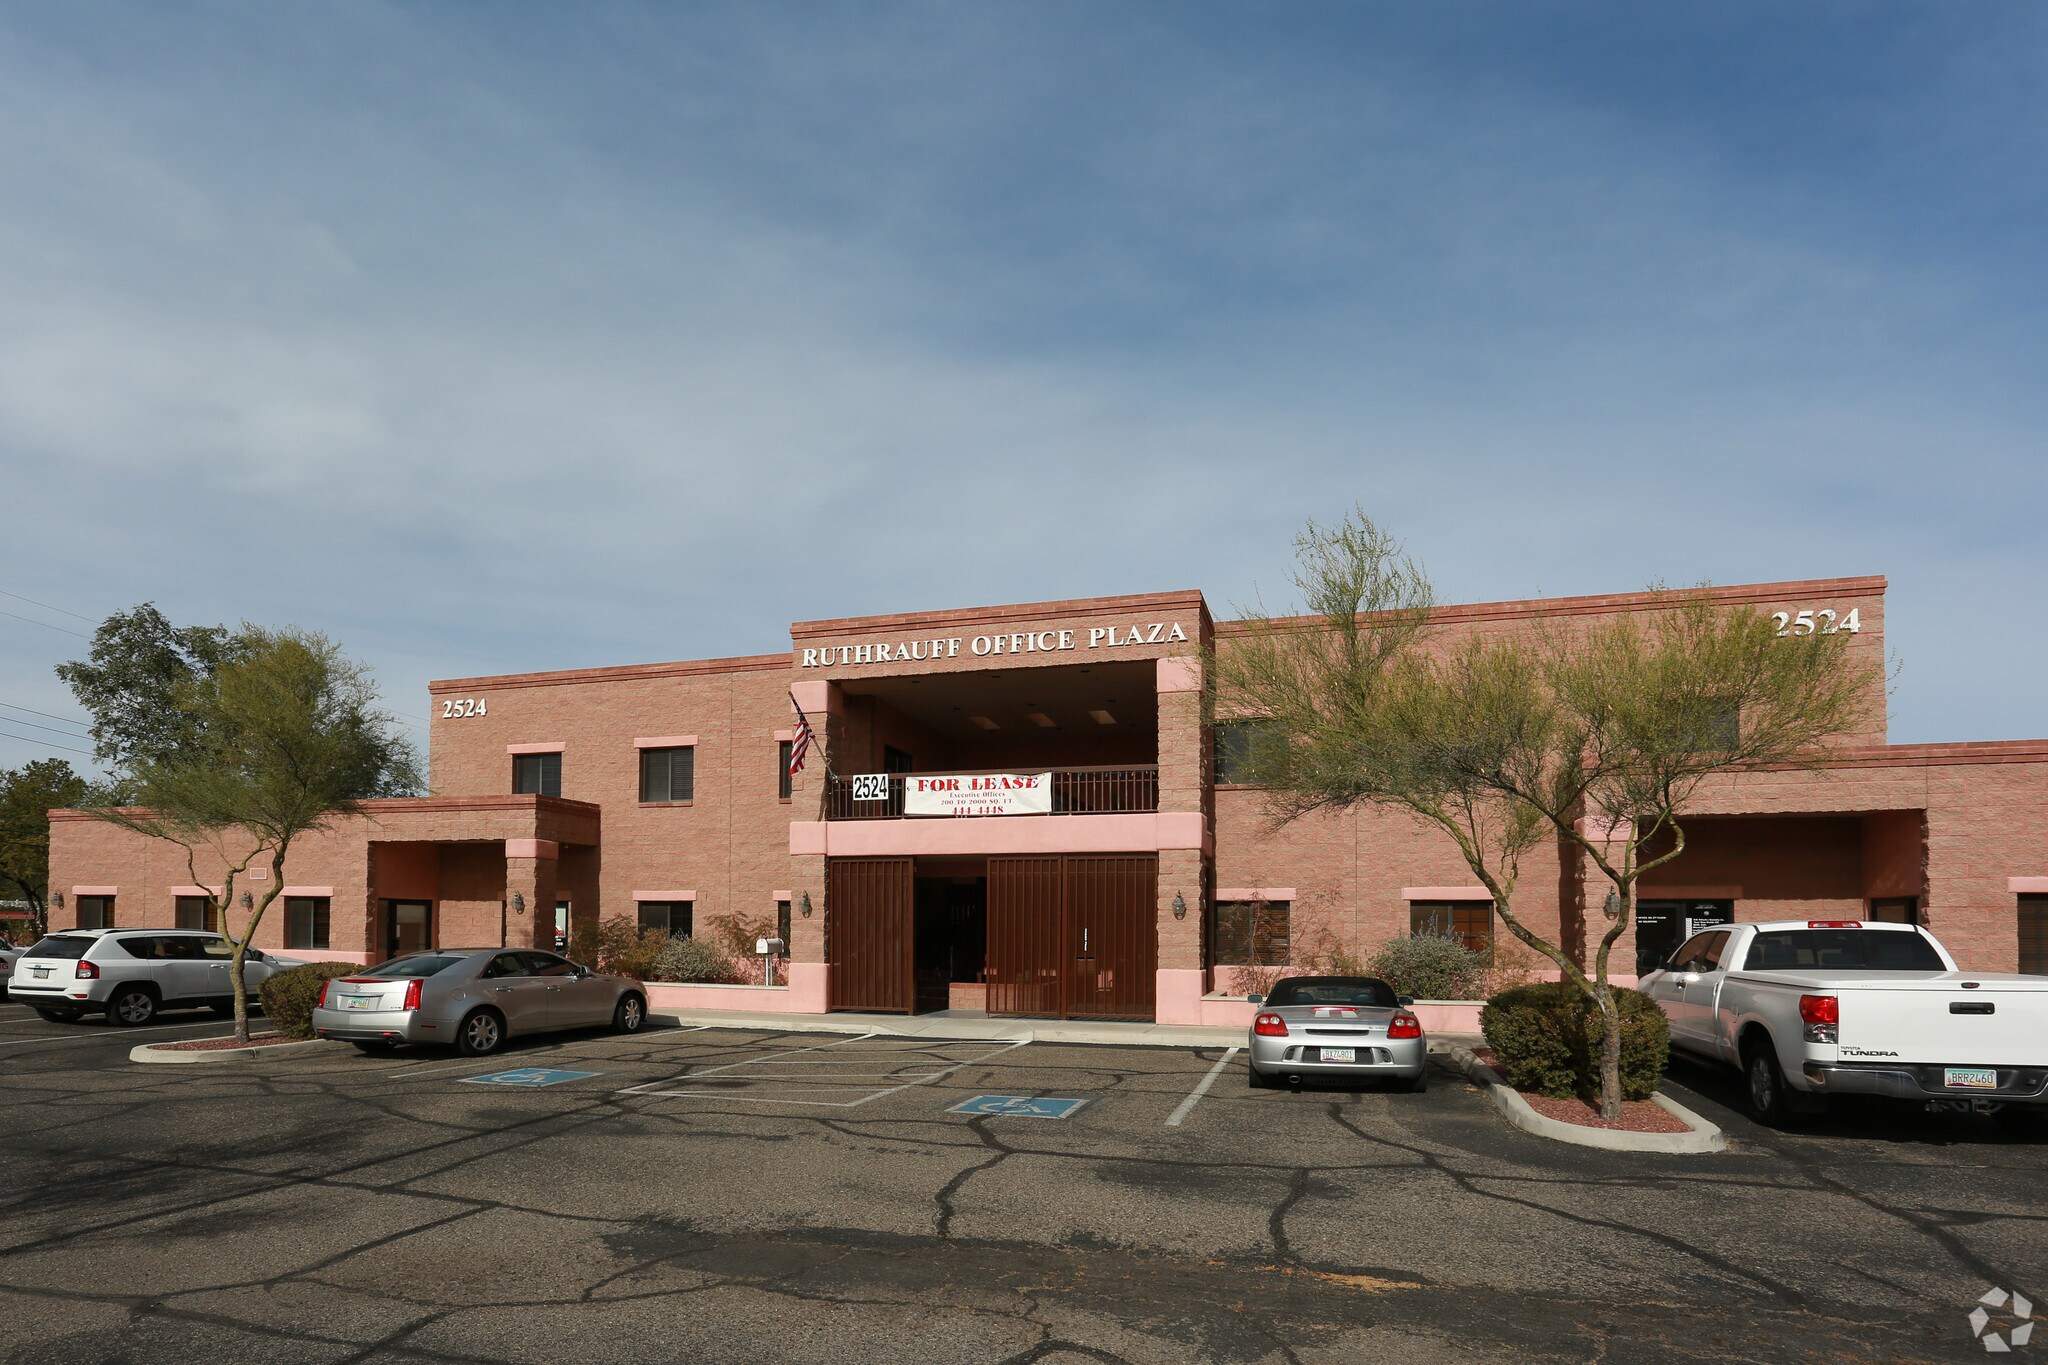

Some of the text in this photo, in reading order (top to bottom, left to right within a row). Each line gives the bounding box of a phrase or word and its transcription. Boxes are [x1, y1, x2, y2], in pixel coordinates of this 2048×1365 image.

[1771, 607, 1860, 637] 2524
[801, 622, 1188, 668] RUTHRAUFF OFFICE PLAZA
[442, 698, 488, 719] 2524
[854, 776, 887, 798] 2524
[918, 776, 1039, 792] FOR LEASE
[952, 806, 1004, 815] 444-4448
[1951, 1072, 1994, 1084] BRR2460
